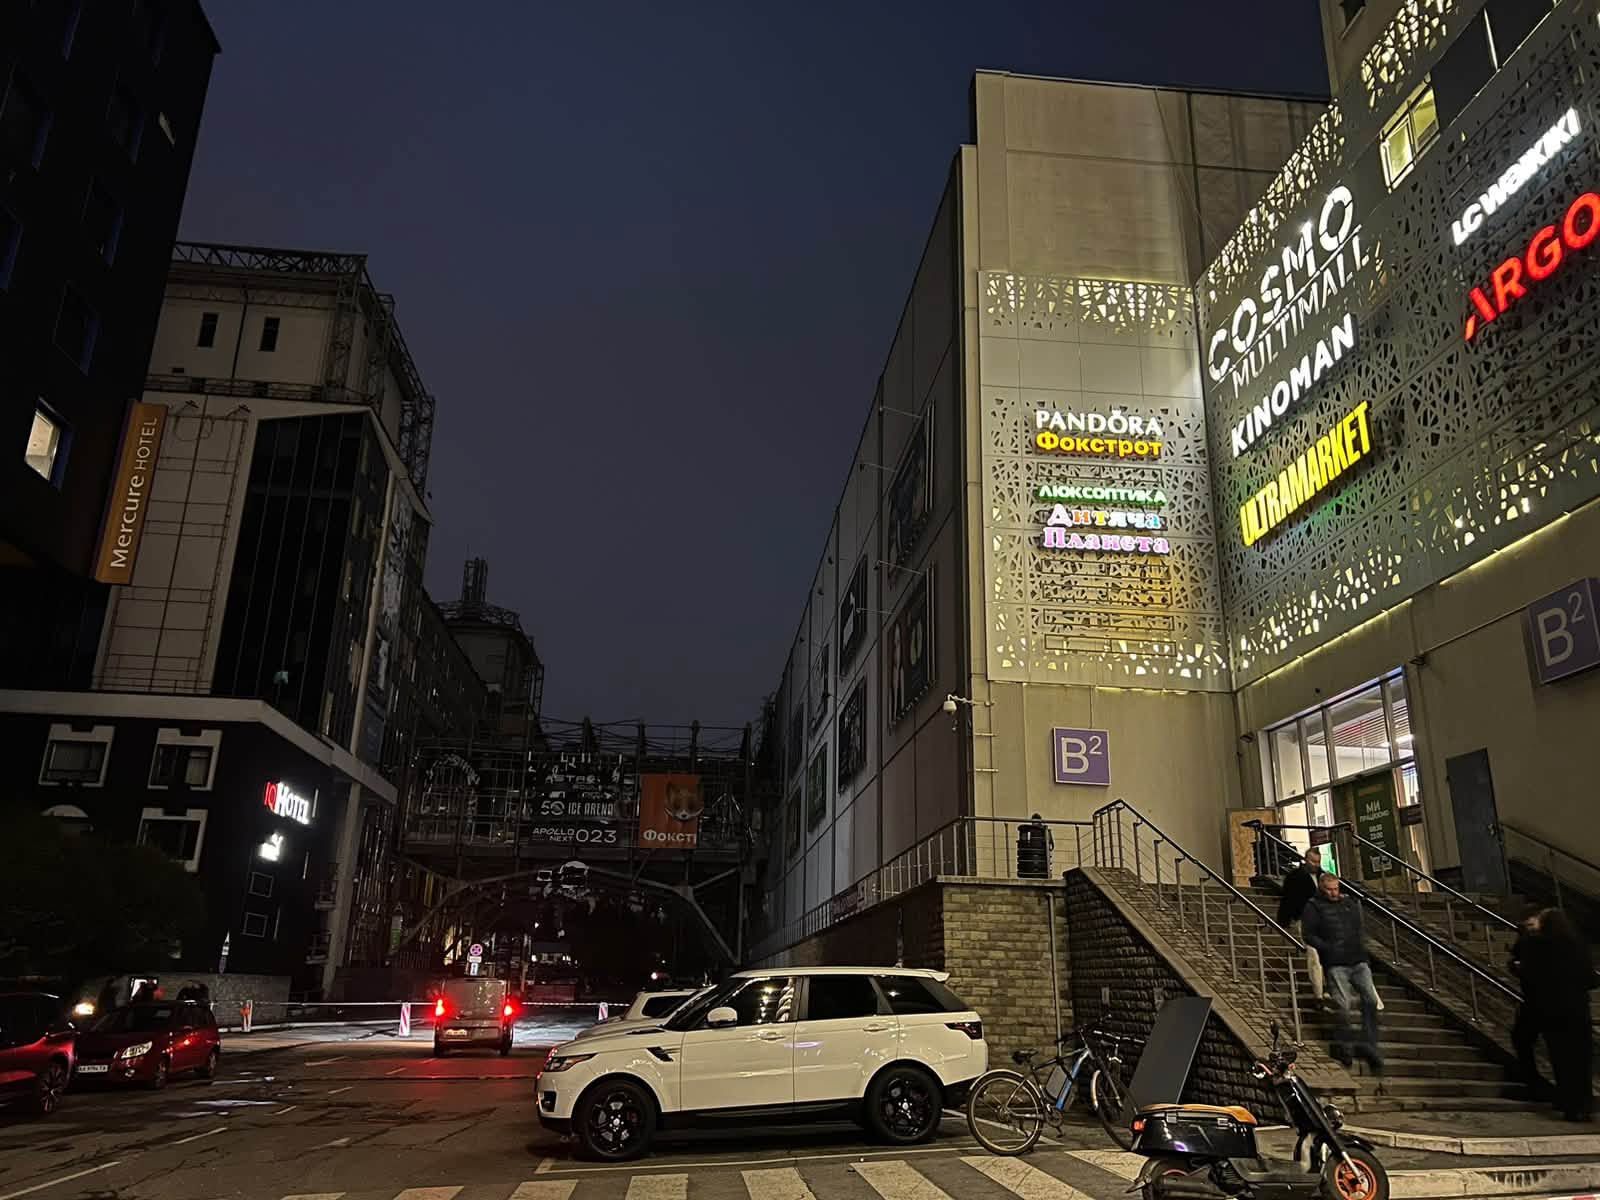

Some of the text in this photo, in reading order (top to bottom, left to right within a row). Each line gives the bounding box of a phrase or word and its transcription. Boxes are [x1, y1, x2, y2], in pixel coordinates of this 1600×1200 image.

[1463, 191, 1600, 342] ARGO
[1208, 185, 1354, 382] COSMO
[1232, 234, 1370, 399] MULTIMALL
[1232, 313, 1355, 458] KINOMAN
[1035, 409, 1163, 437] PANDORA
[1036, 431, 1163, 457] Фокстрот
[1239, 401, 1371, 548] ULTRAMARKET
[110, 417, 158, 568] Mercure HOTEL
[1038, 485, 1168, 504] ЛЮКСОПТИКА
[1047, 503, 1163, 530] Дитяча
[1042, 527, 1170, 554] Планета
[568, 802, 582, 815] ICE
[532, 827, 575, 836] APOLLO
[576, 829, 617, 843] 023
